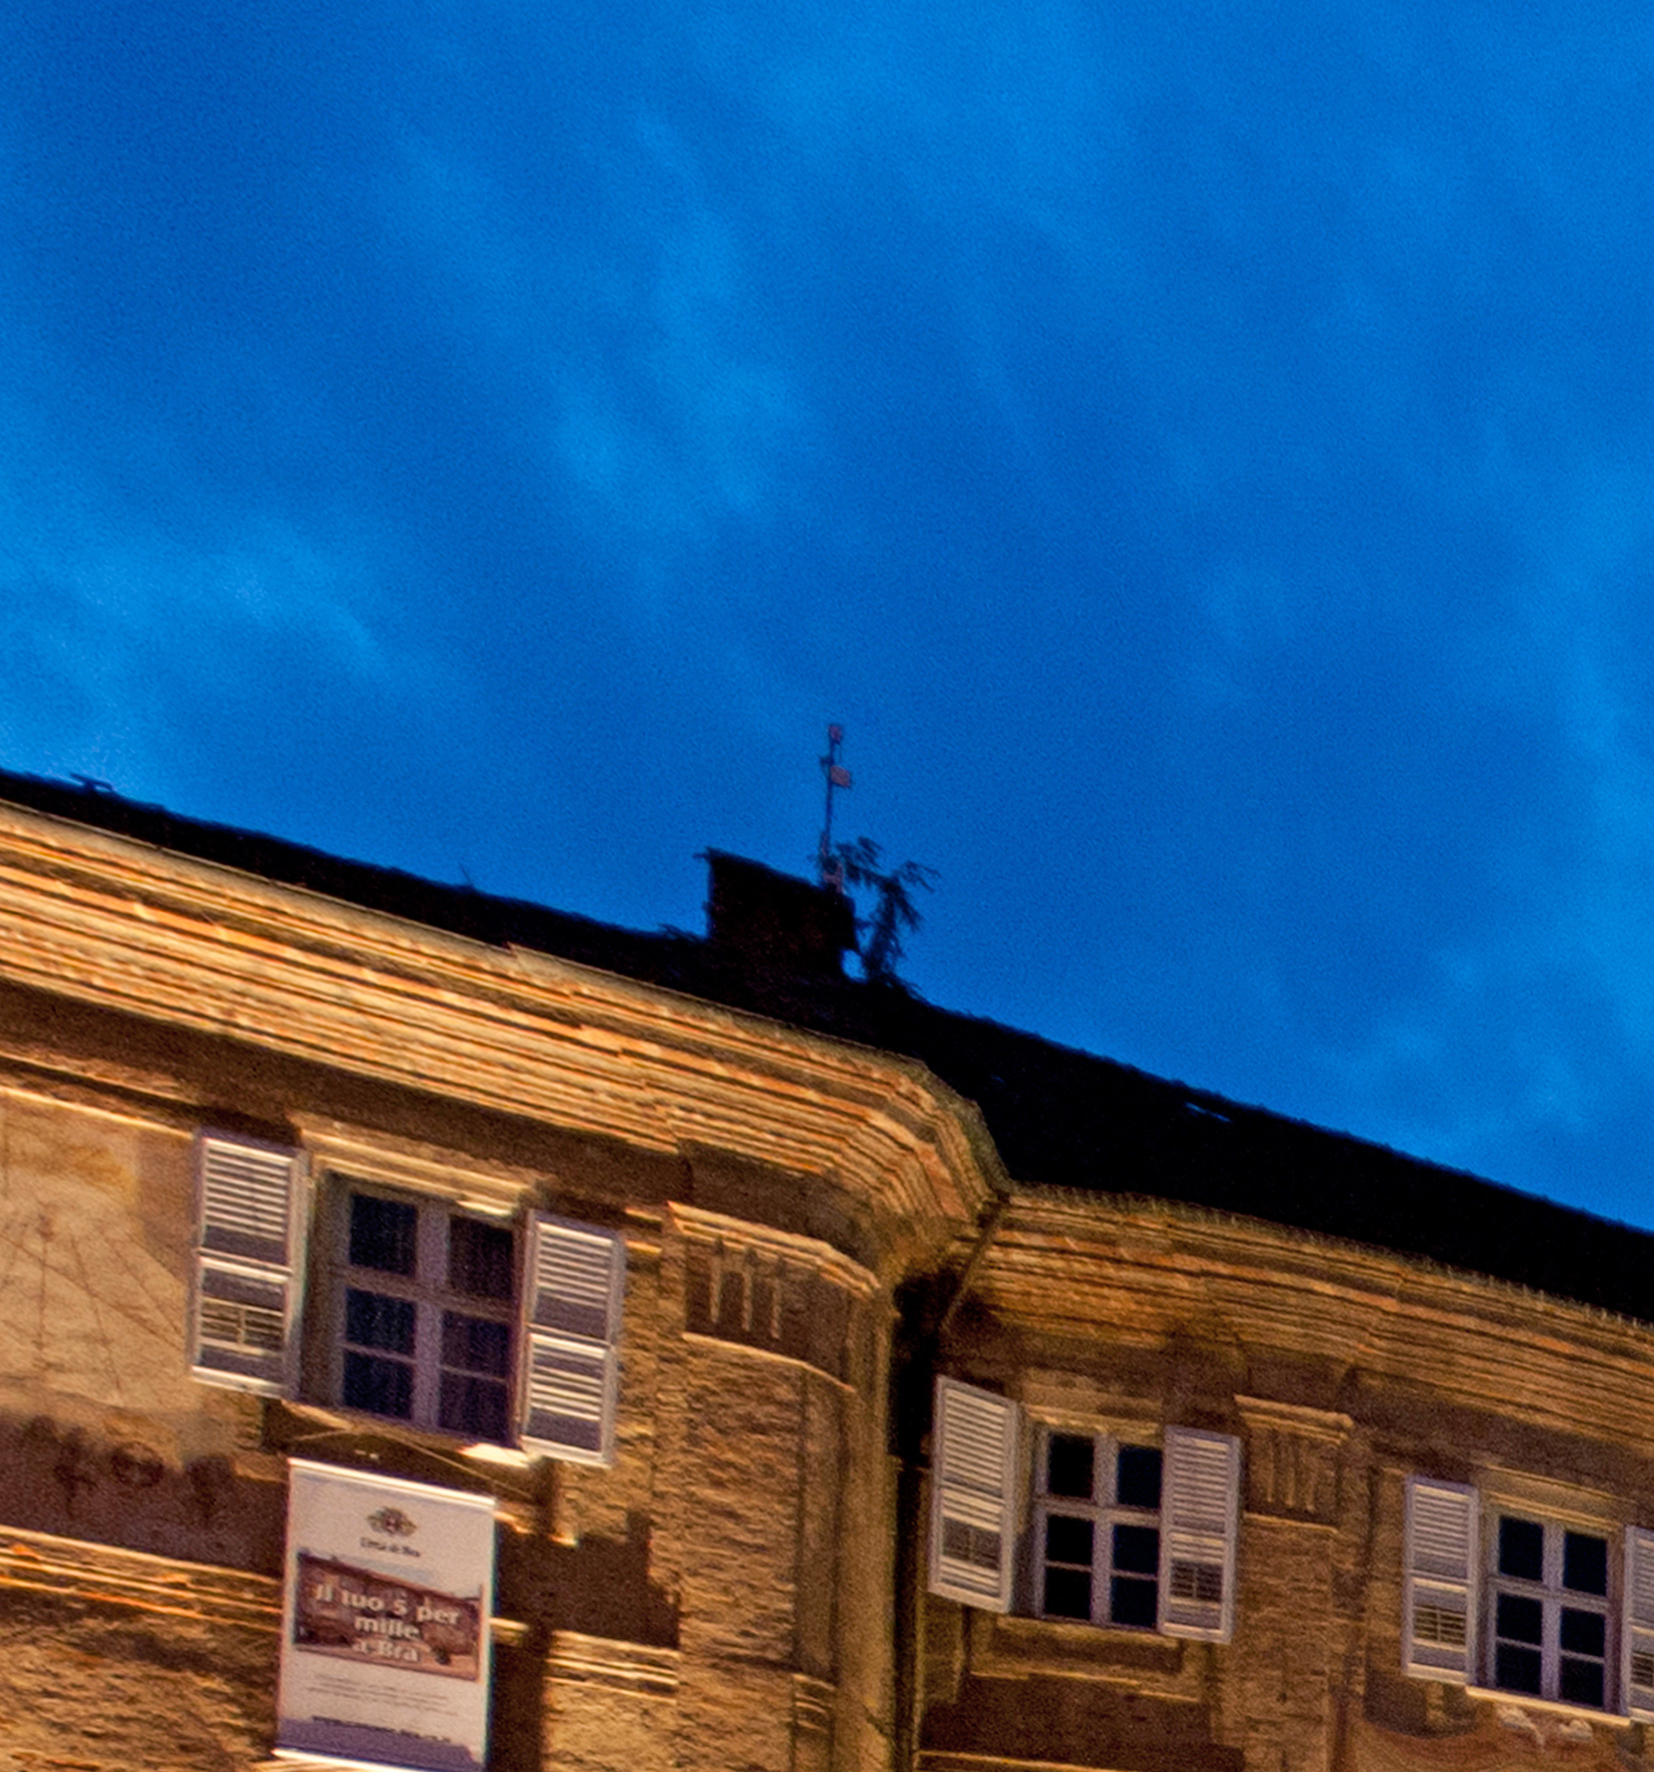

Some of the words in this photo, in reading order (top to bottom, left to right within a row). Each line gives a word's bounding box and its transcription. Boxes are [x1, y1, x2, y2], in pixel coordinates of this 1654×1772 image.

[341, 1589, 386, 1612] tuo
[416, 1603, 461, 1626] per
[354, 1615, 420, 1639] mille
[351, 1640, 369, 1655] a
[377, 1640, 419, 1662] Bra
